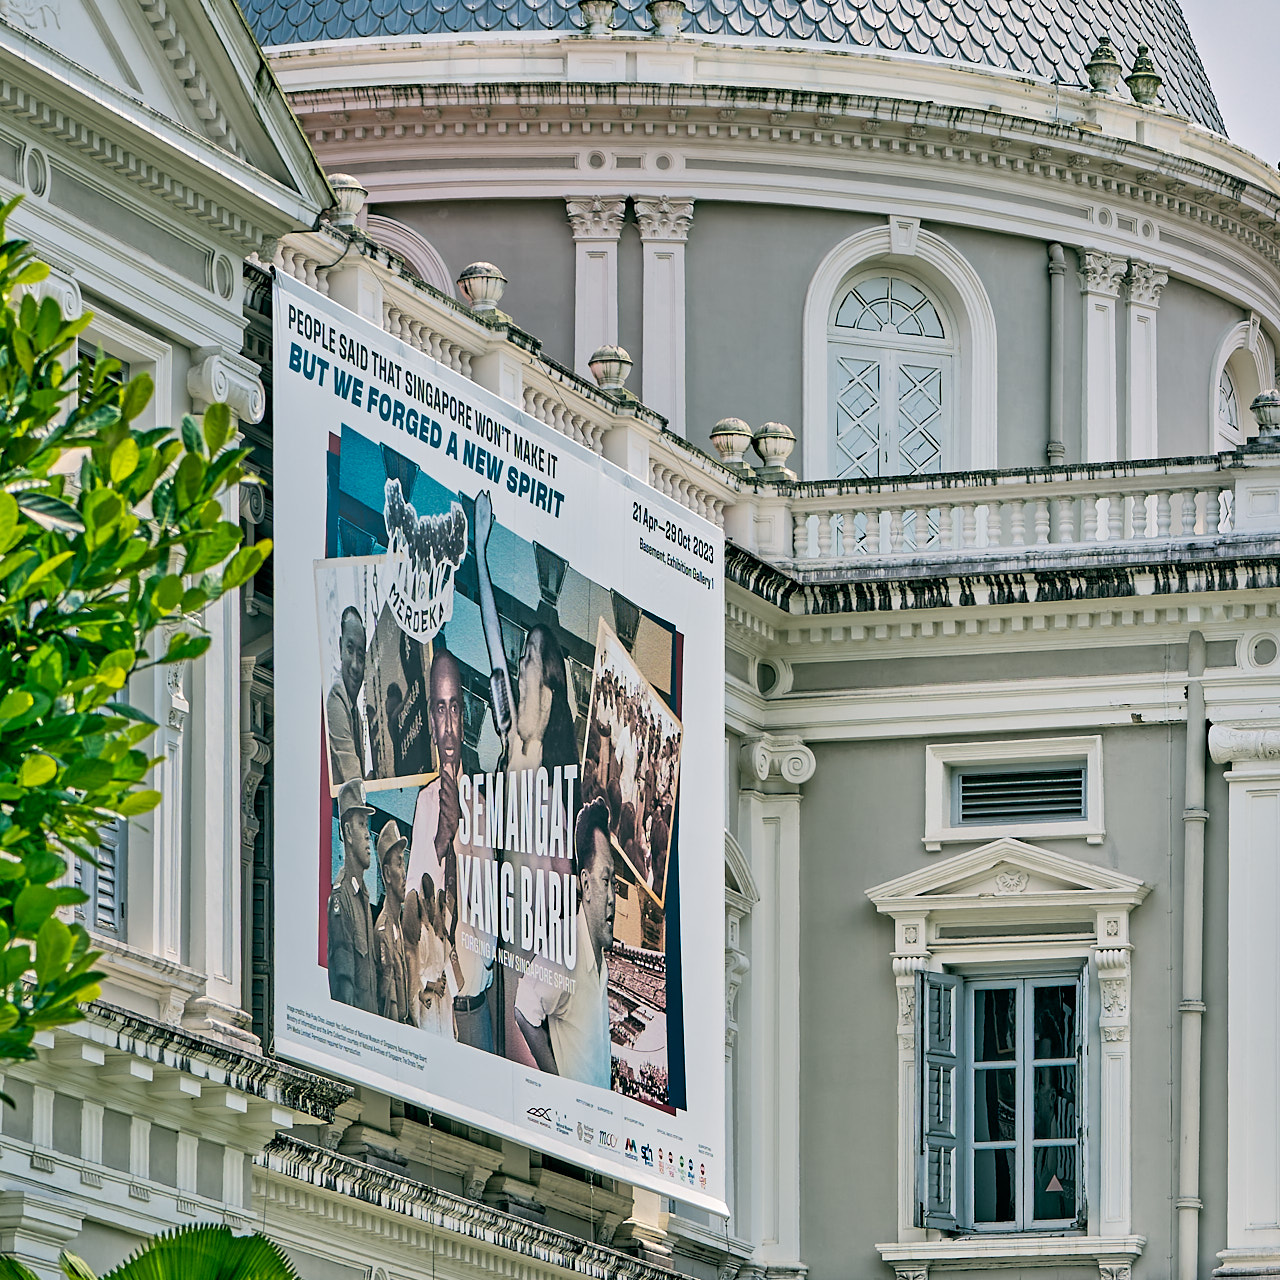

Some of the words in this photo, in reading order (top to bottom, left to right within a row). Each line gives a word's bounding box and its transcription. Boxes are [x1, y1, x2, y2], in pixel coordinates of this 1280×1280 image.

[288, 303, 336, 354] PEOPLE
[339, 333, 368, 371] SAID
[372, 350, 402, 390] THAT
[405, 370, 472, 431] SINGAPORE
[475, 409, 511, 453] WON'T
[514, 433, 545, 473] MAKE
[547, 452, 558, 479] IT
[288, 341, 330, 387] BUT
[334, 365, 364, 408] WE
[367, 385, 442, 449] FORGED
[445, 431, 458, 461] A
[463, 439, 504, 484] NEW
[506, 465, 565, 519] SPIRIT
[633, 501, 642, 523] 21
[678, 528, 691, 551] Oct
[693, 536, 714, 564] 2023
[640, 536, 666, 565] Basement,
[667, 553, 692, 578] Exhibition
[692, 567, 711, 590] Gallery
[458, 764, 578, 860] SEMANGAT
[458, 853, 515, 945] YANG
[520, 864, 578, 971] BARU
[461, 931, 490, 960] FORGING
[492, 944, 498, 963] A
[498, 948, 514, 970] NEW
[515, 954, 553, 987] SINGAPORE
[554, 971, 576, 995] SPIRIT
